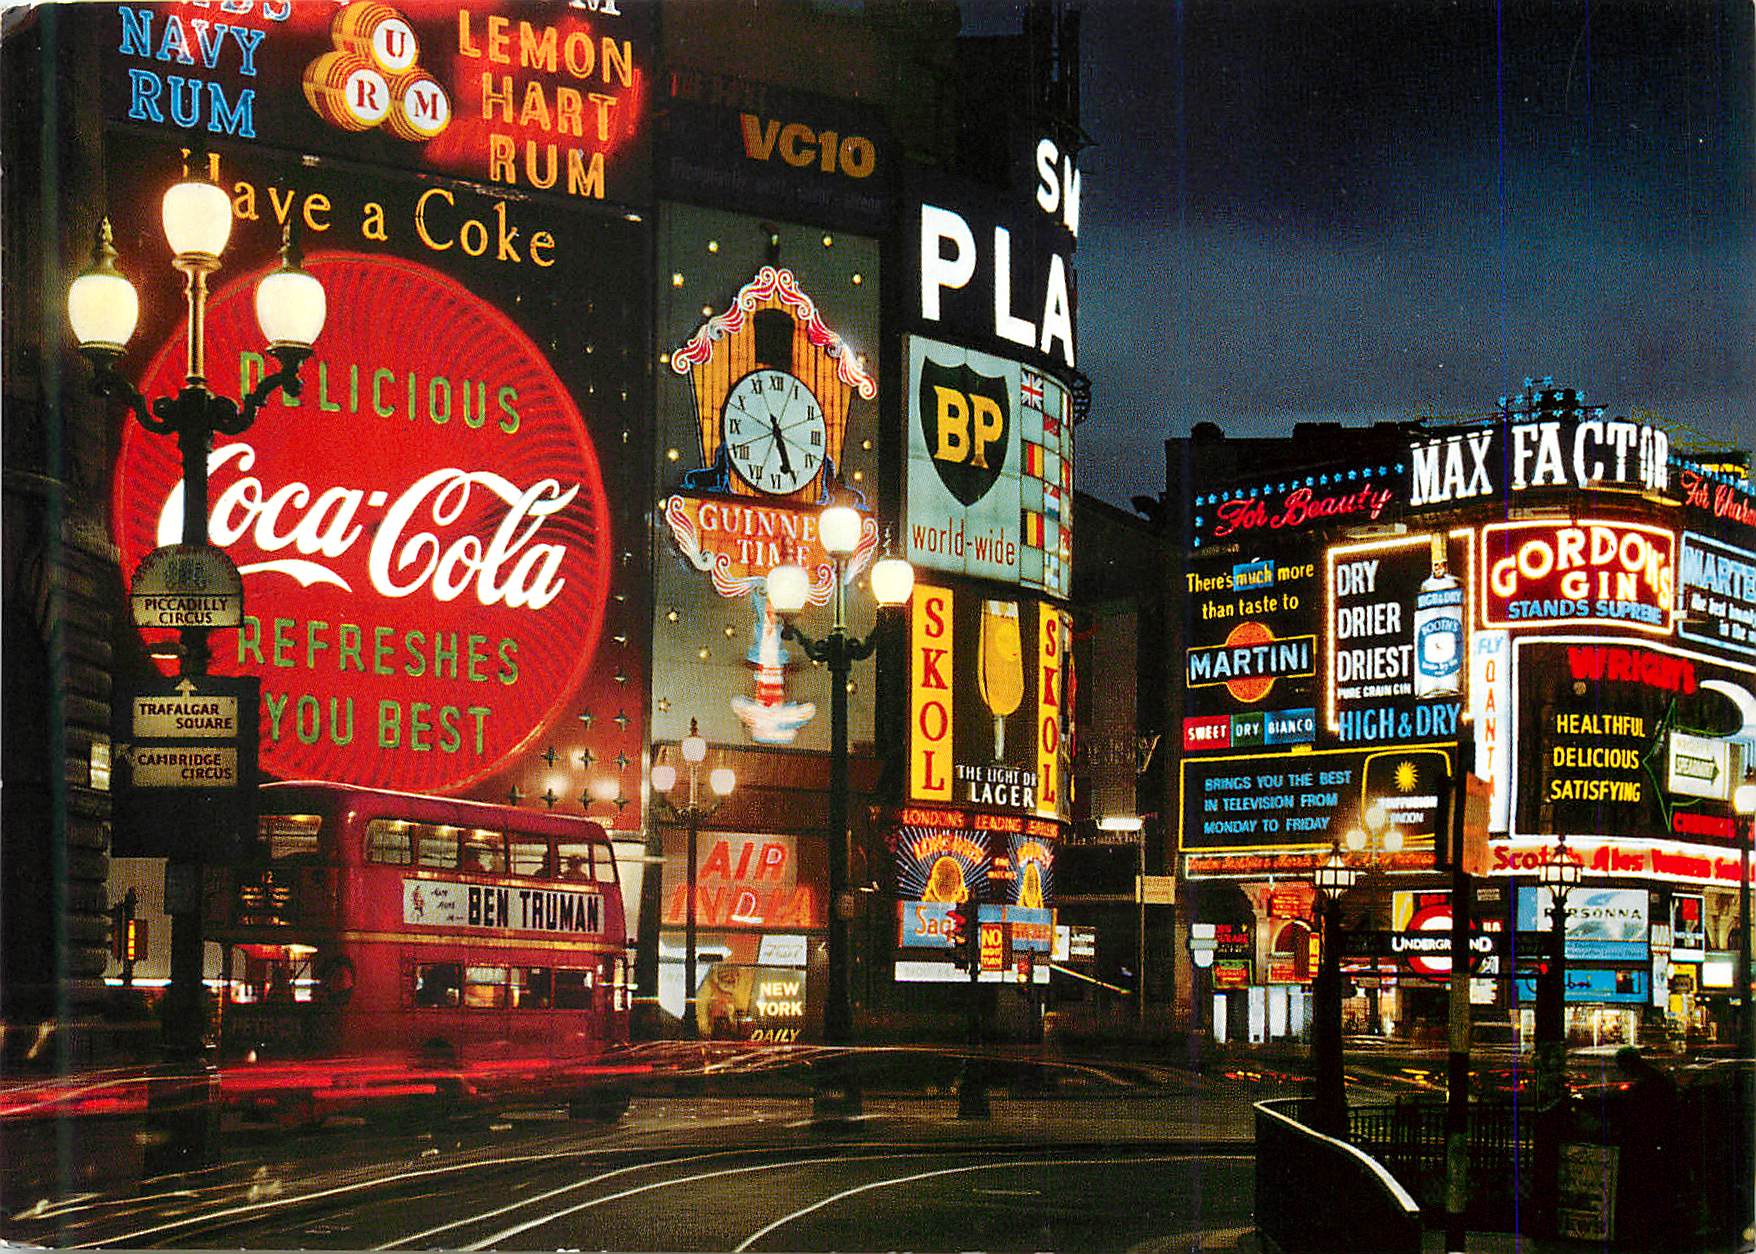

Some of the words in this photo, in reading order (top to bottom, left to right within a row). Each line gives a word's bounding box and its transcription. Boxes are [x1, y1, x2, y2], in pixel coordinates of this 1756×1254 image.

[119, 7, 266, 76] NAVY
[385, 29, 405, 57] U
[459, 9, 632, 88] LEMON
[129, 69, 257, 138] RUM
[355, 79, 380, 110] R
[413, 90, 439, 120] M
[482, 72, 617, 141] HART
[740, 113, 876, 178] VC10
[489, 134, 605, 199] RUM
[361, 201, 388, 241] a
[415, 187, 557, 267] Coke
[921, 203, 1075, 368] PLA
[240, 351, 521, 434] DLICIOUS
[933, 385, 1004, 469] BP
[1410, 429, 1493, 506] MAX
[1510, 421, 1669, 492] FACTOR
[698, 503, 817, 543] GUINNE
[1214, 498, 1268, 537] For
[1269, 482, 1393, 529] Beauty
[156, 441, 581, 610] Coca-Cola
[912, 518, 1016, 566] world-wide
[1186, 572, 1233, 594] There's
[1235, 563, 1273, 586] much
[1277, 564, 1315, 582] more
[1337, 559, 1380, 596] DRY
[1560, 570, 1639, 601] GIN
[144, 598, 228, 612] PICCADILLY
[158, 611, 214, 625] CIRCUS
[1202, 600, 1234, 619] than
[1239, 596, 1278, 616] taste
[1283, 594, 1299, 610] to
[1508, 599, 1591, 621] STANDS
[1595, 602, 1663, 625] SUPREME
[1337, 602, 1401, 640] DRIER
[238, 615, 520, 686] REFRESHES
[1190, 643, 1309, 681] MARTINI
[1337, 645, 1413, 682] DRIEST
[919, 597, 948, 791] SKOL
[1337, 686, 1362, 700] PURE
[1362, 684, 1393, 698] GRAIN
[1393, 682, 1412, 695] GIN
[139, 703, 220, 716] TRAFALGAR
[176, 717, 233, 730] SQUARE
[266, 692, 354, 745] YOU
[378, 699, 492, 756] BEST
[1042, 619, 1058, 804] SKOL
[1339, 707, 1395, 742] HIGH
[1415, 703, 1462, 737] DRY
[1187, 723, 1227, 741] SWEET
[1235, 721, 1260, 737] DRY
[1268, 718, 1314, 734] BIANCO
[1556, 713, 1646, 738] HEALTHFUL
[137, 753, 222, 766] CAMBRIDGE
[181, 767, 232, 780] CIRCUS
[1553, 746, 1640, 770] DELICIOUS
[957, 765, 982, 782] THE
[987, 767, 1019, 785] LIGHT
[1204, 776, 1251, 792] BRINGS
[1257, 774, 1283, 790] YOU
[1288, 773, 1313, 787] THE
[1319, 770, 1352, 785] BEST
[971, 782, 1036, 808] LAGER
[1204, 798, 1218, 812] IN
[1222, 795, 1294, 811] TELEVISION
[1300, 793, 1338, 807] FROM
[1550, 779, 1641, 803] SATISFYING
[1203, 820, 1257, 835] MONDAY
[1262, 818, 1279, 832] TO
[1285, 816, 1331, 831] FRIDAY
[700, 840, 788, 881] AIR
[1492, 845, 1584, 870] Scoth
[1589, 846, 1645, 872] Ales
[468, 887, 510, 927] BEN
[519, 891, 599, 932] TRUMAN
[1544, 906, 1643, 920] PRSONNA
[981, 928, 1003, 946] NO
[1391, 935, 1493, 952] UNDERGRND
[760, 982, 800, 997] NEW
[756, 1000, 803, 1017] YORK
[751, 1029, 800, 1042] DAILY
